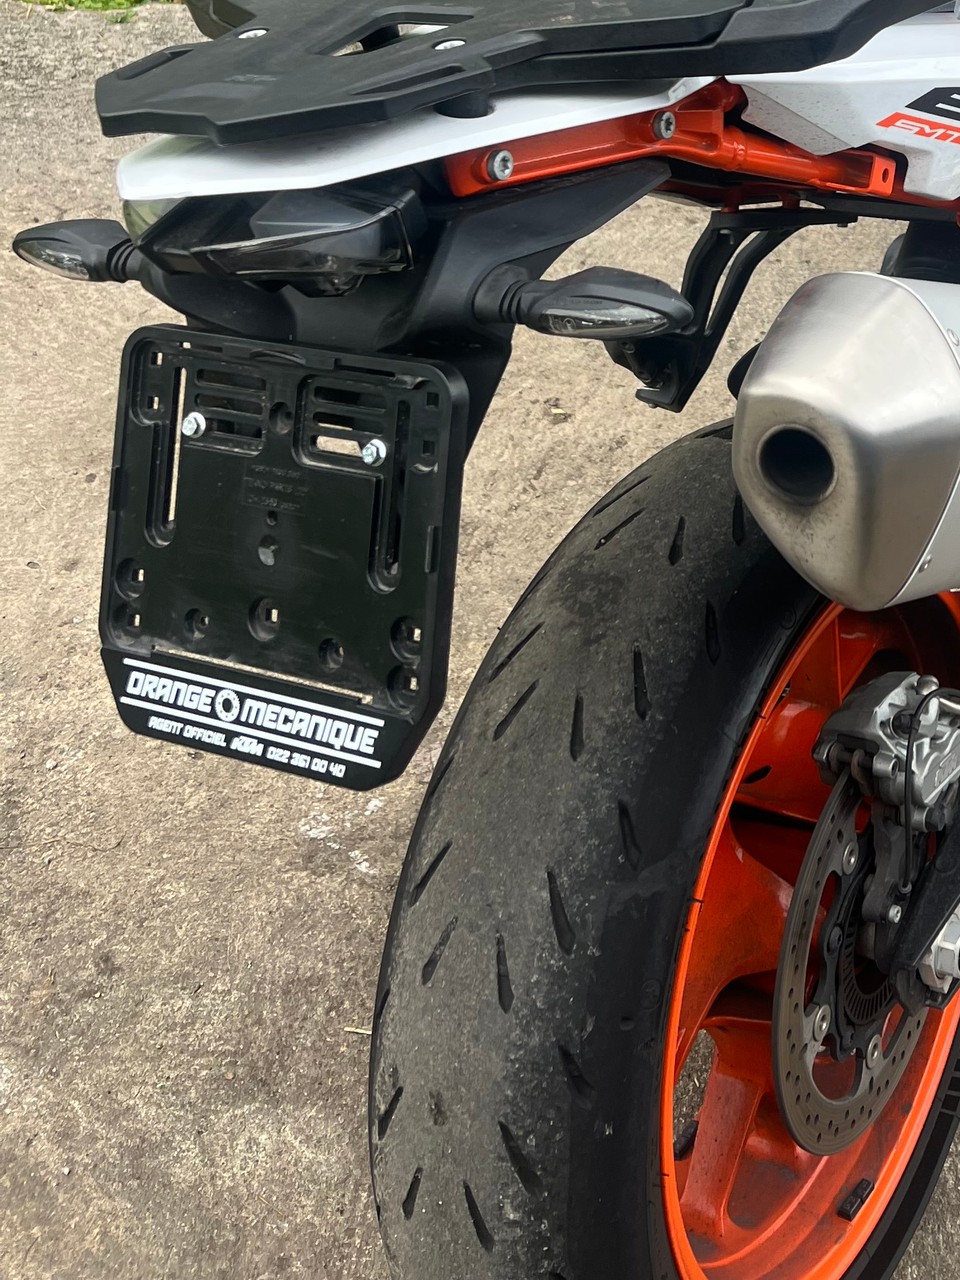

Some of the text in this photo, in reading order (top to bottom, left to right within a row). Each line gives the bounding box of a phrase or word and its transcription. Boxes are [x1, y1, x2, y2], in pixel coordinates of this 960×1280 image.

[126, 670, 380, 755] ORANGE MECANIQUE
[148, 716, 184, 735] AGENT
[182, 724, 227, 747] OFFICIEL
[229, 735, 264, 756] KTM
[266, 746, 290, 764] 022
[310, 757, 329, 773] 00
[329, 762, 346, 778] 40
